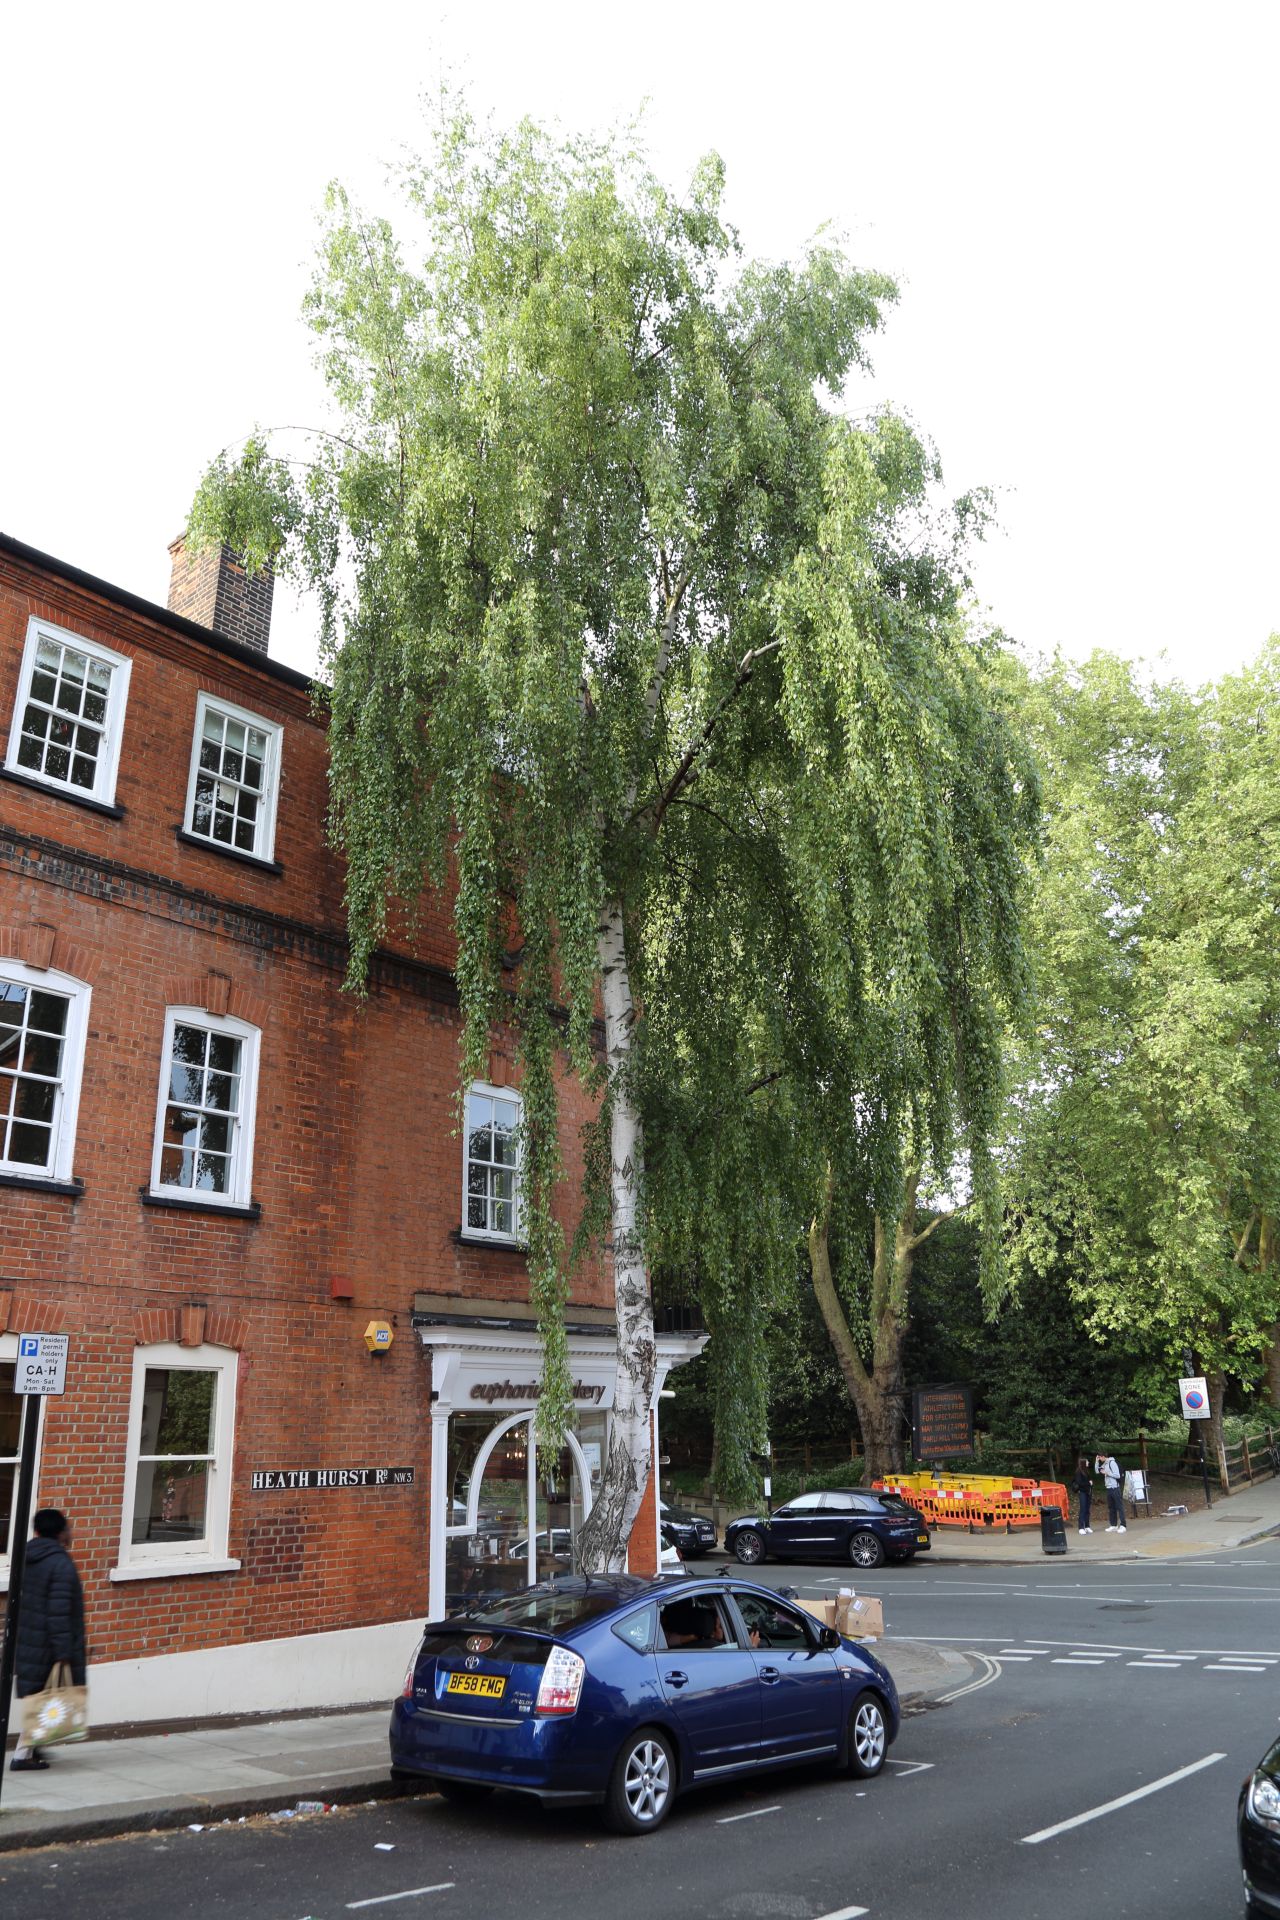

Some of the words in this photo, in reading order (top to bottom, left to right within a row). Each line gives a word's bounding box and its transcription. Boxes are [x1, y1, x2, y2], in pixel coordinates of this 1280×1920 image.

[25, 1340, 37, 1355] P
[252, 1471, 309, 1489] HEATH
[317, 1469, 369, 1487] HURST
[450, 1675, 479, 1691] BF58
[480, 1678, 503, 1694] FMG
